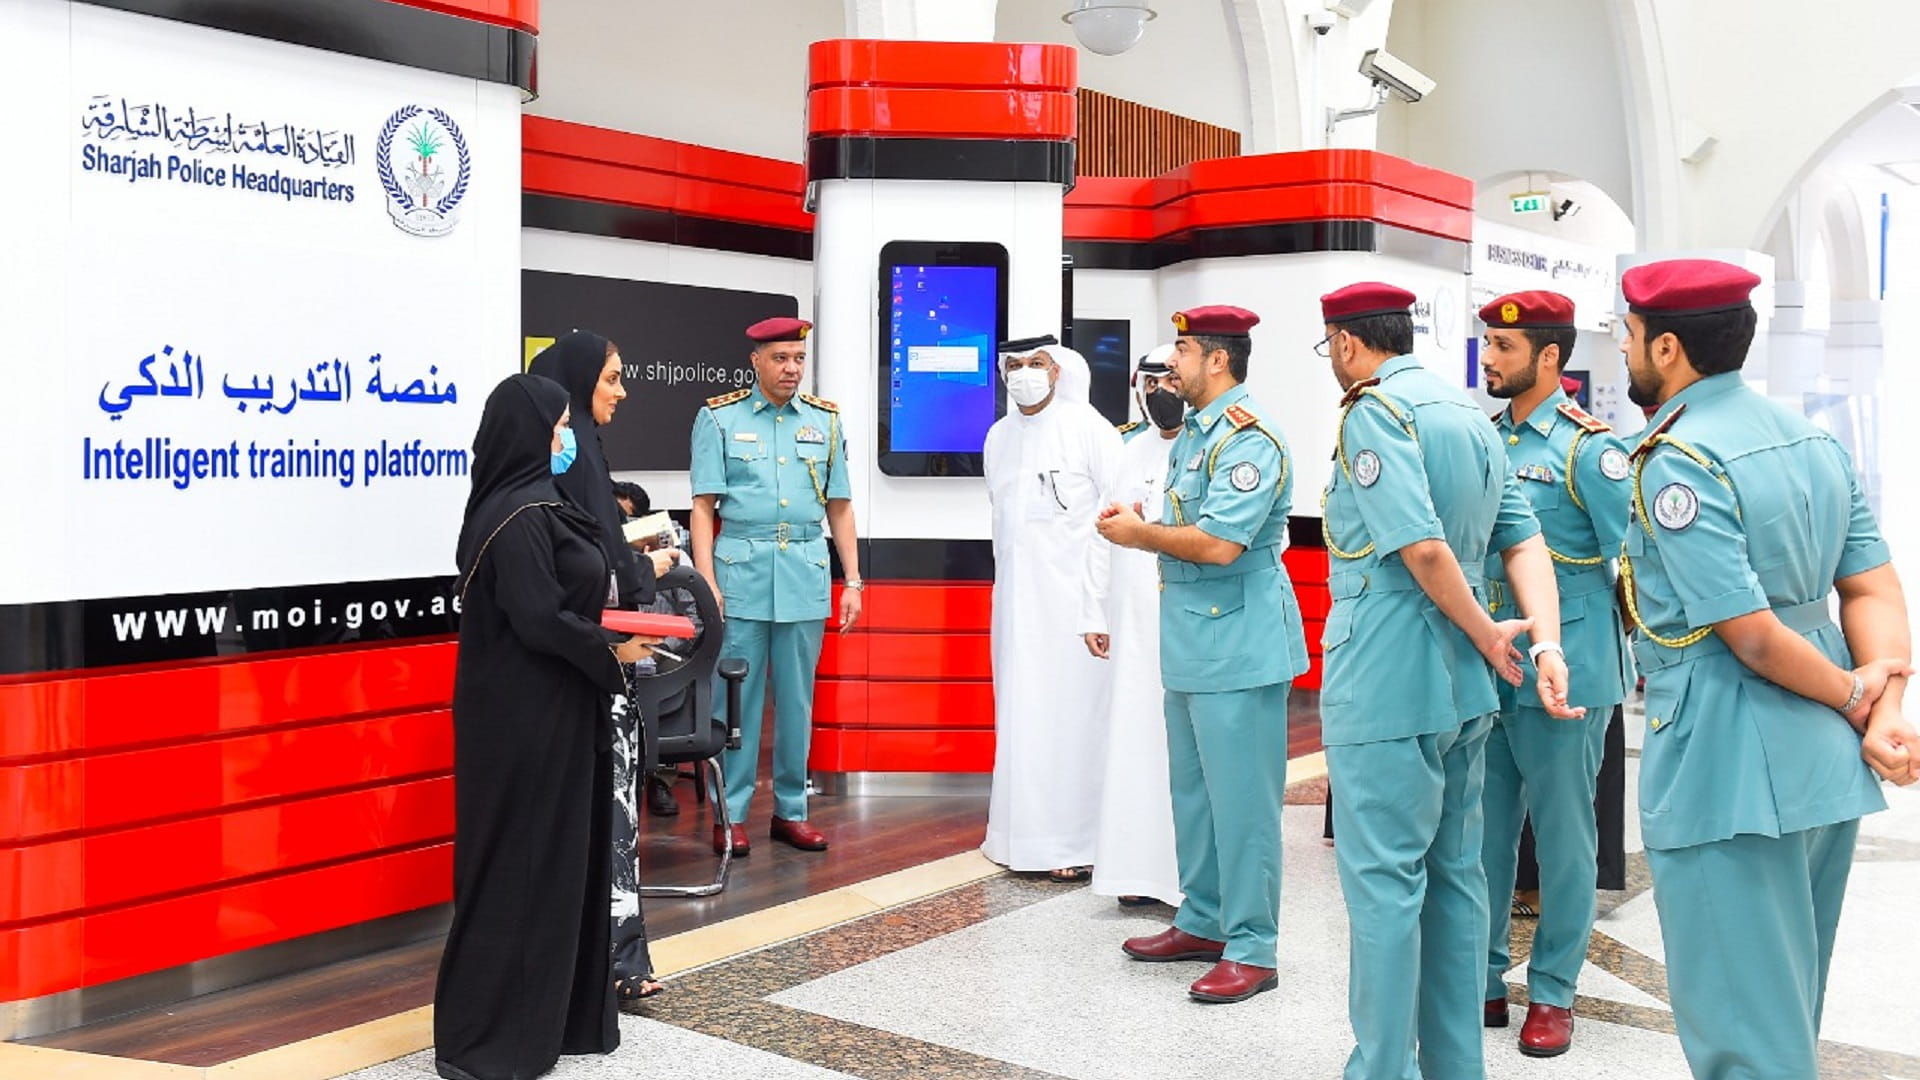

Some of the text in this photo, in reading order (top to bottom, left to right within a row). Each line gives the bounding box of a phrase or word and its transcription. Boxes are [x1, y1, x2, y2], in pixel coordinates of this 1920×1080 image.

[82, 144, 355, 203] Sharjah Police Headquarters
[99, 345, 458, 421] منصة التدريب الذكي
[83, 437, 468, 490] Intelligent training platform
